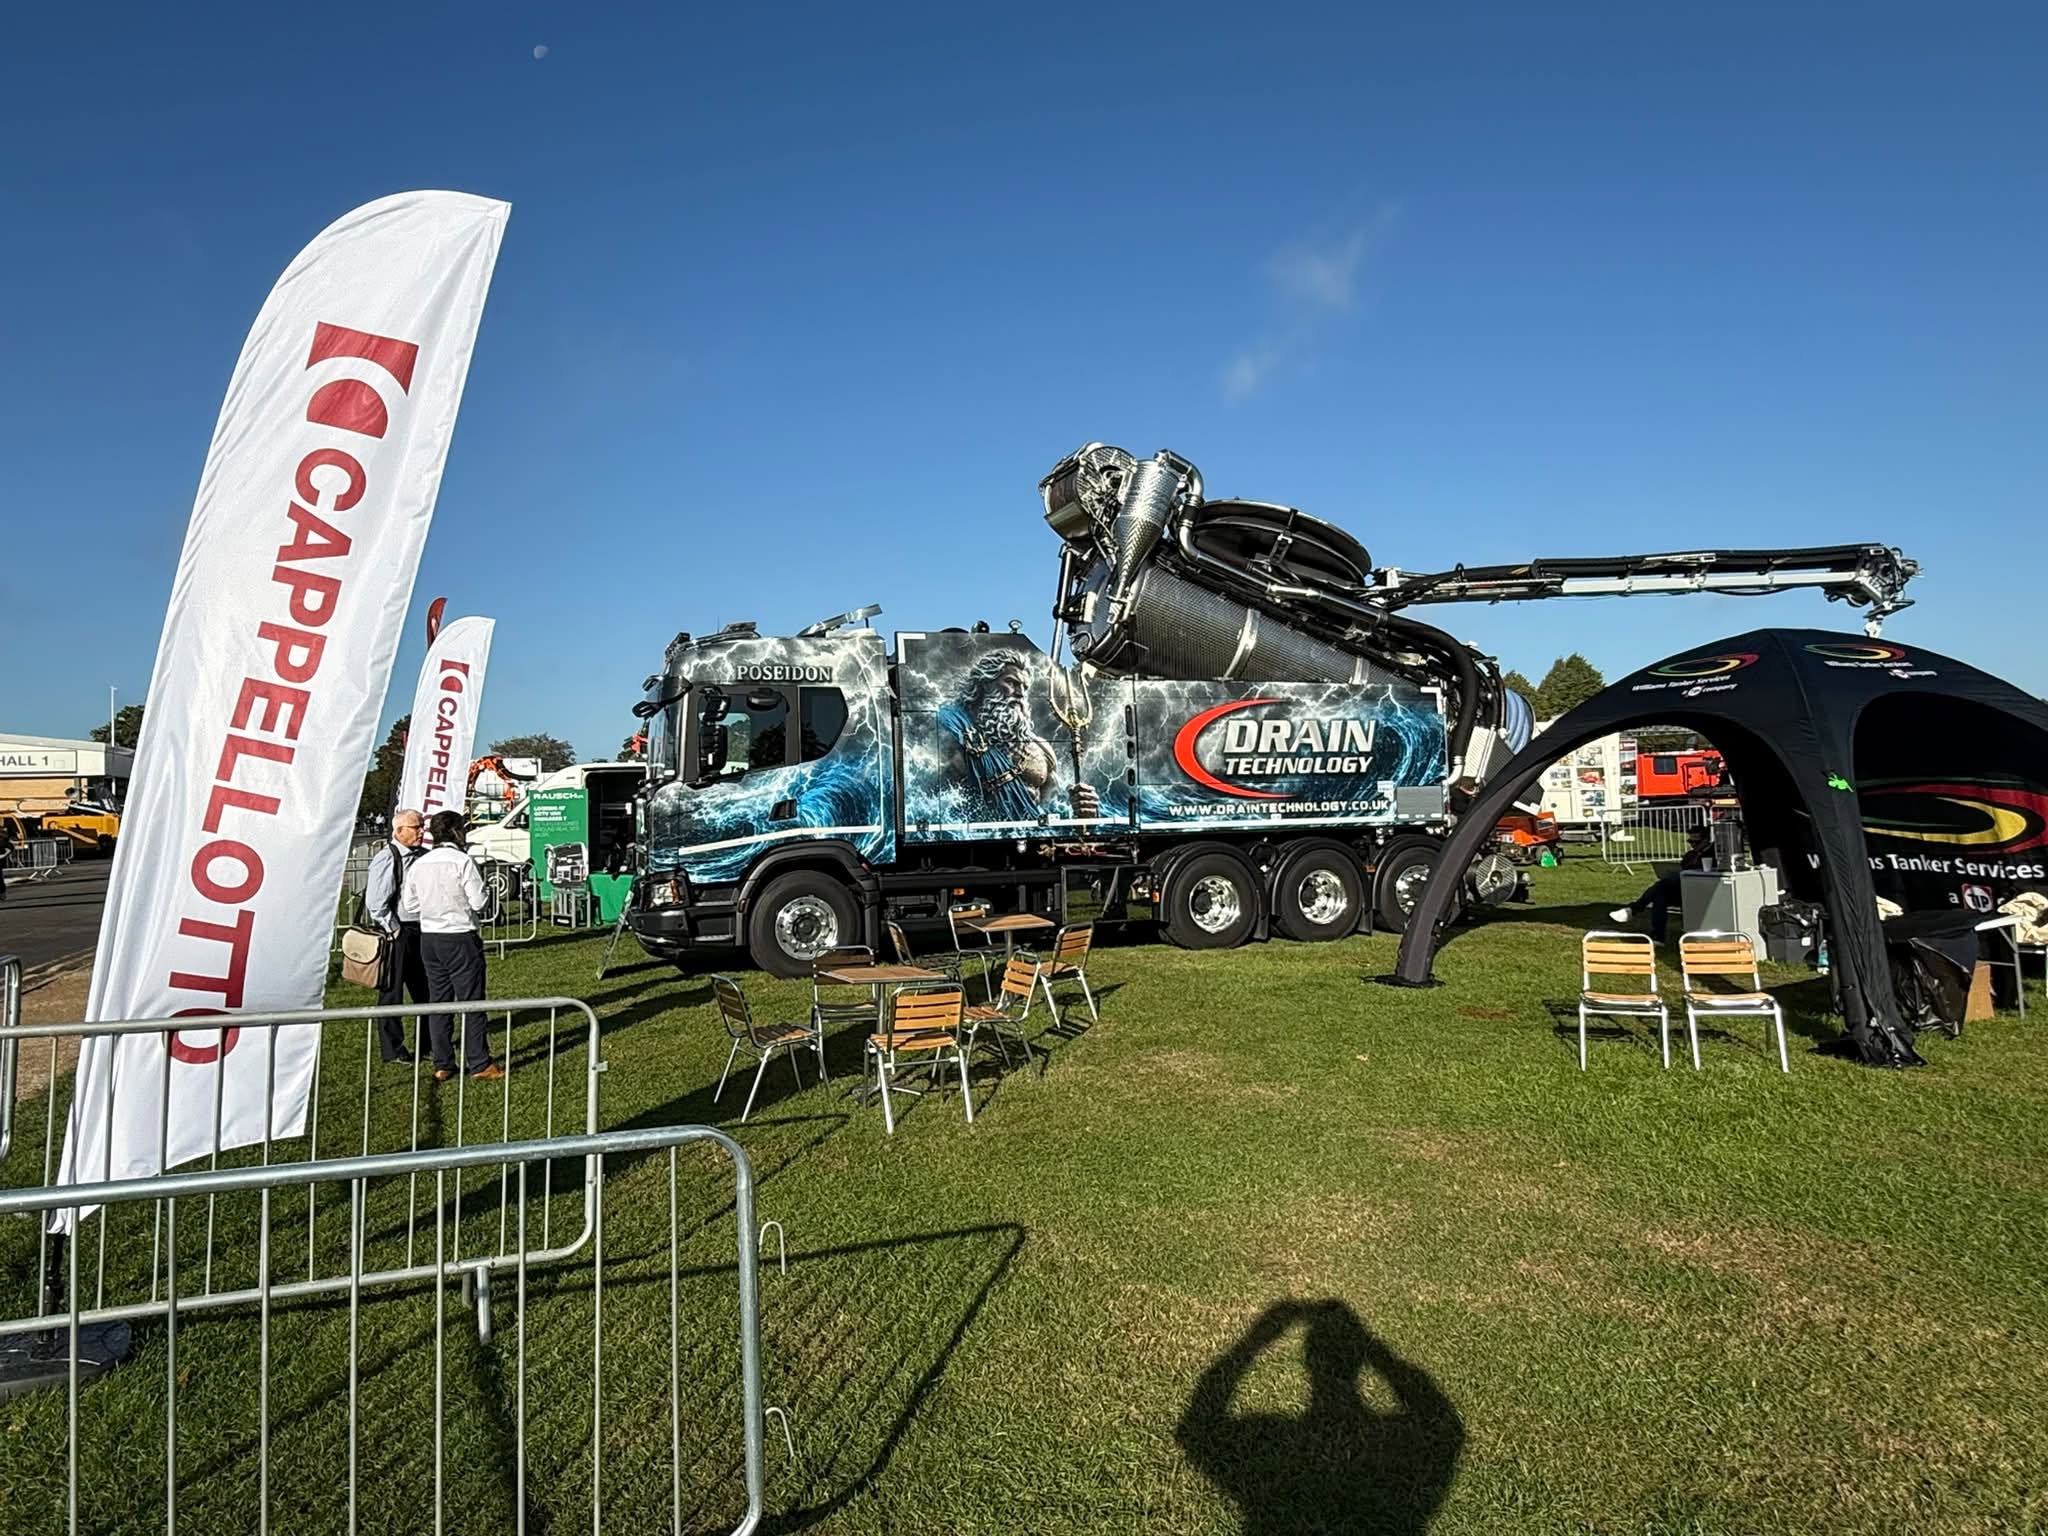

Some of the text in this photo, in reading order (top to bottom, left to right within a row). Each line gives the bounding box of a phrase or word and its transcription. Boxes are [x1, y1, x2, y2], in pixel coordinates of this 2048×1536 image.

[737, 665, 833, 681] POSEIDON
[1223, 719, 1376, 753] DRAIN
[42, 755, 48, 766] 1
[166, 448, 367, 1065] CAPPELLOTTO
[1225, 756, 1373, 775] TECHNOLOGY
[422, 696, 458, 846] CAPPELL
[1169, 799, 1390, 816] WWW.DRAINTECHNOLOGY.CO.UK
[1886, 853, 1951, 873] Tanker
[1954, 857, 2045, 880] Services
[1948, 891, 1960, 904] a
